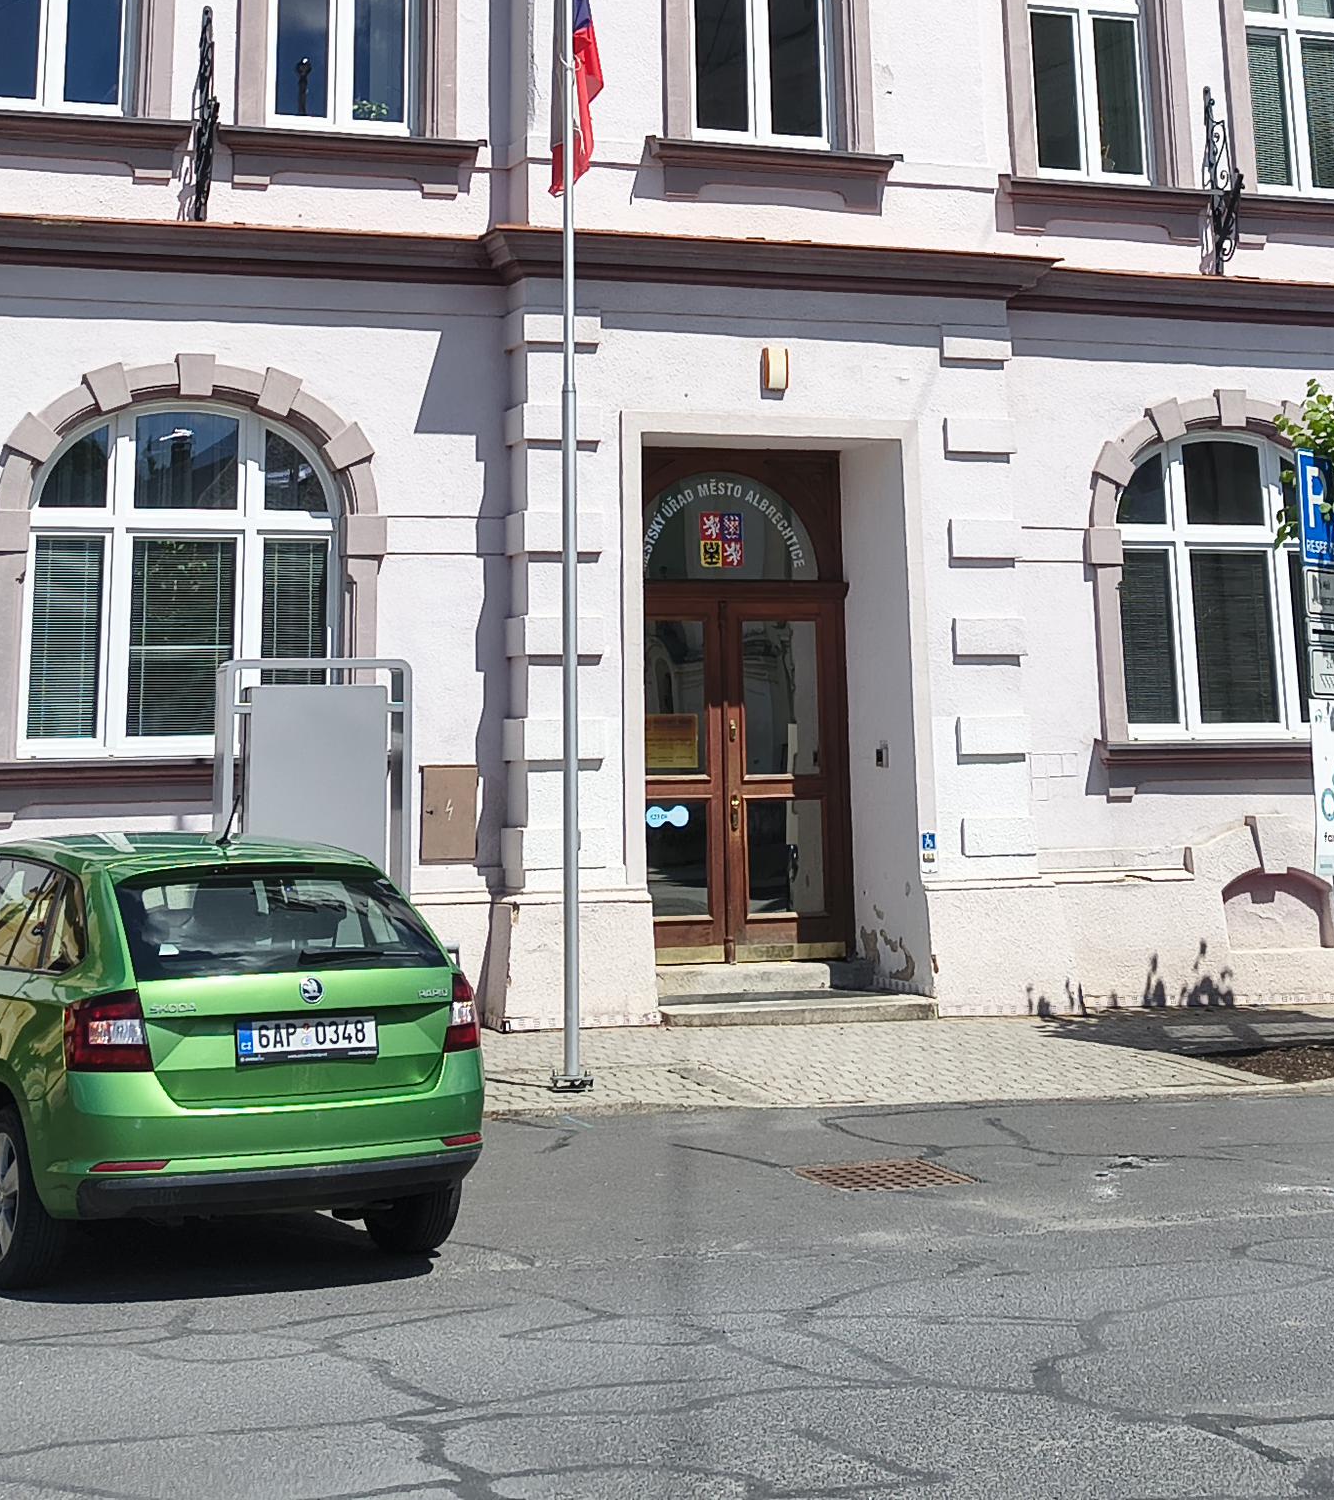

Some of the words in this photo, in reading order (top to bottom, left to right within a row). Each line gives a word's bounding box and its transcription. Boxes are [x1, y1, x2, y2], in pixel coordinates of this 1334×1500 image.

[661, 488, 694, 518] ÚŘAD
[697, 479, 742, 498] MĚSTO
[745, 490, 805, 569] ALBRECHTICE
[1306, 465, 1327, 528] P
[258, 1022, 297, 1048] 6AP
[314, 1020, 366, 1045] 0348
